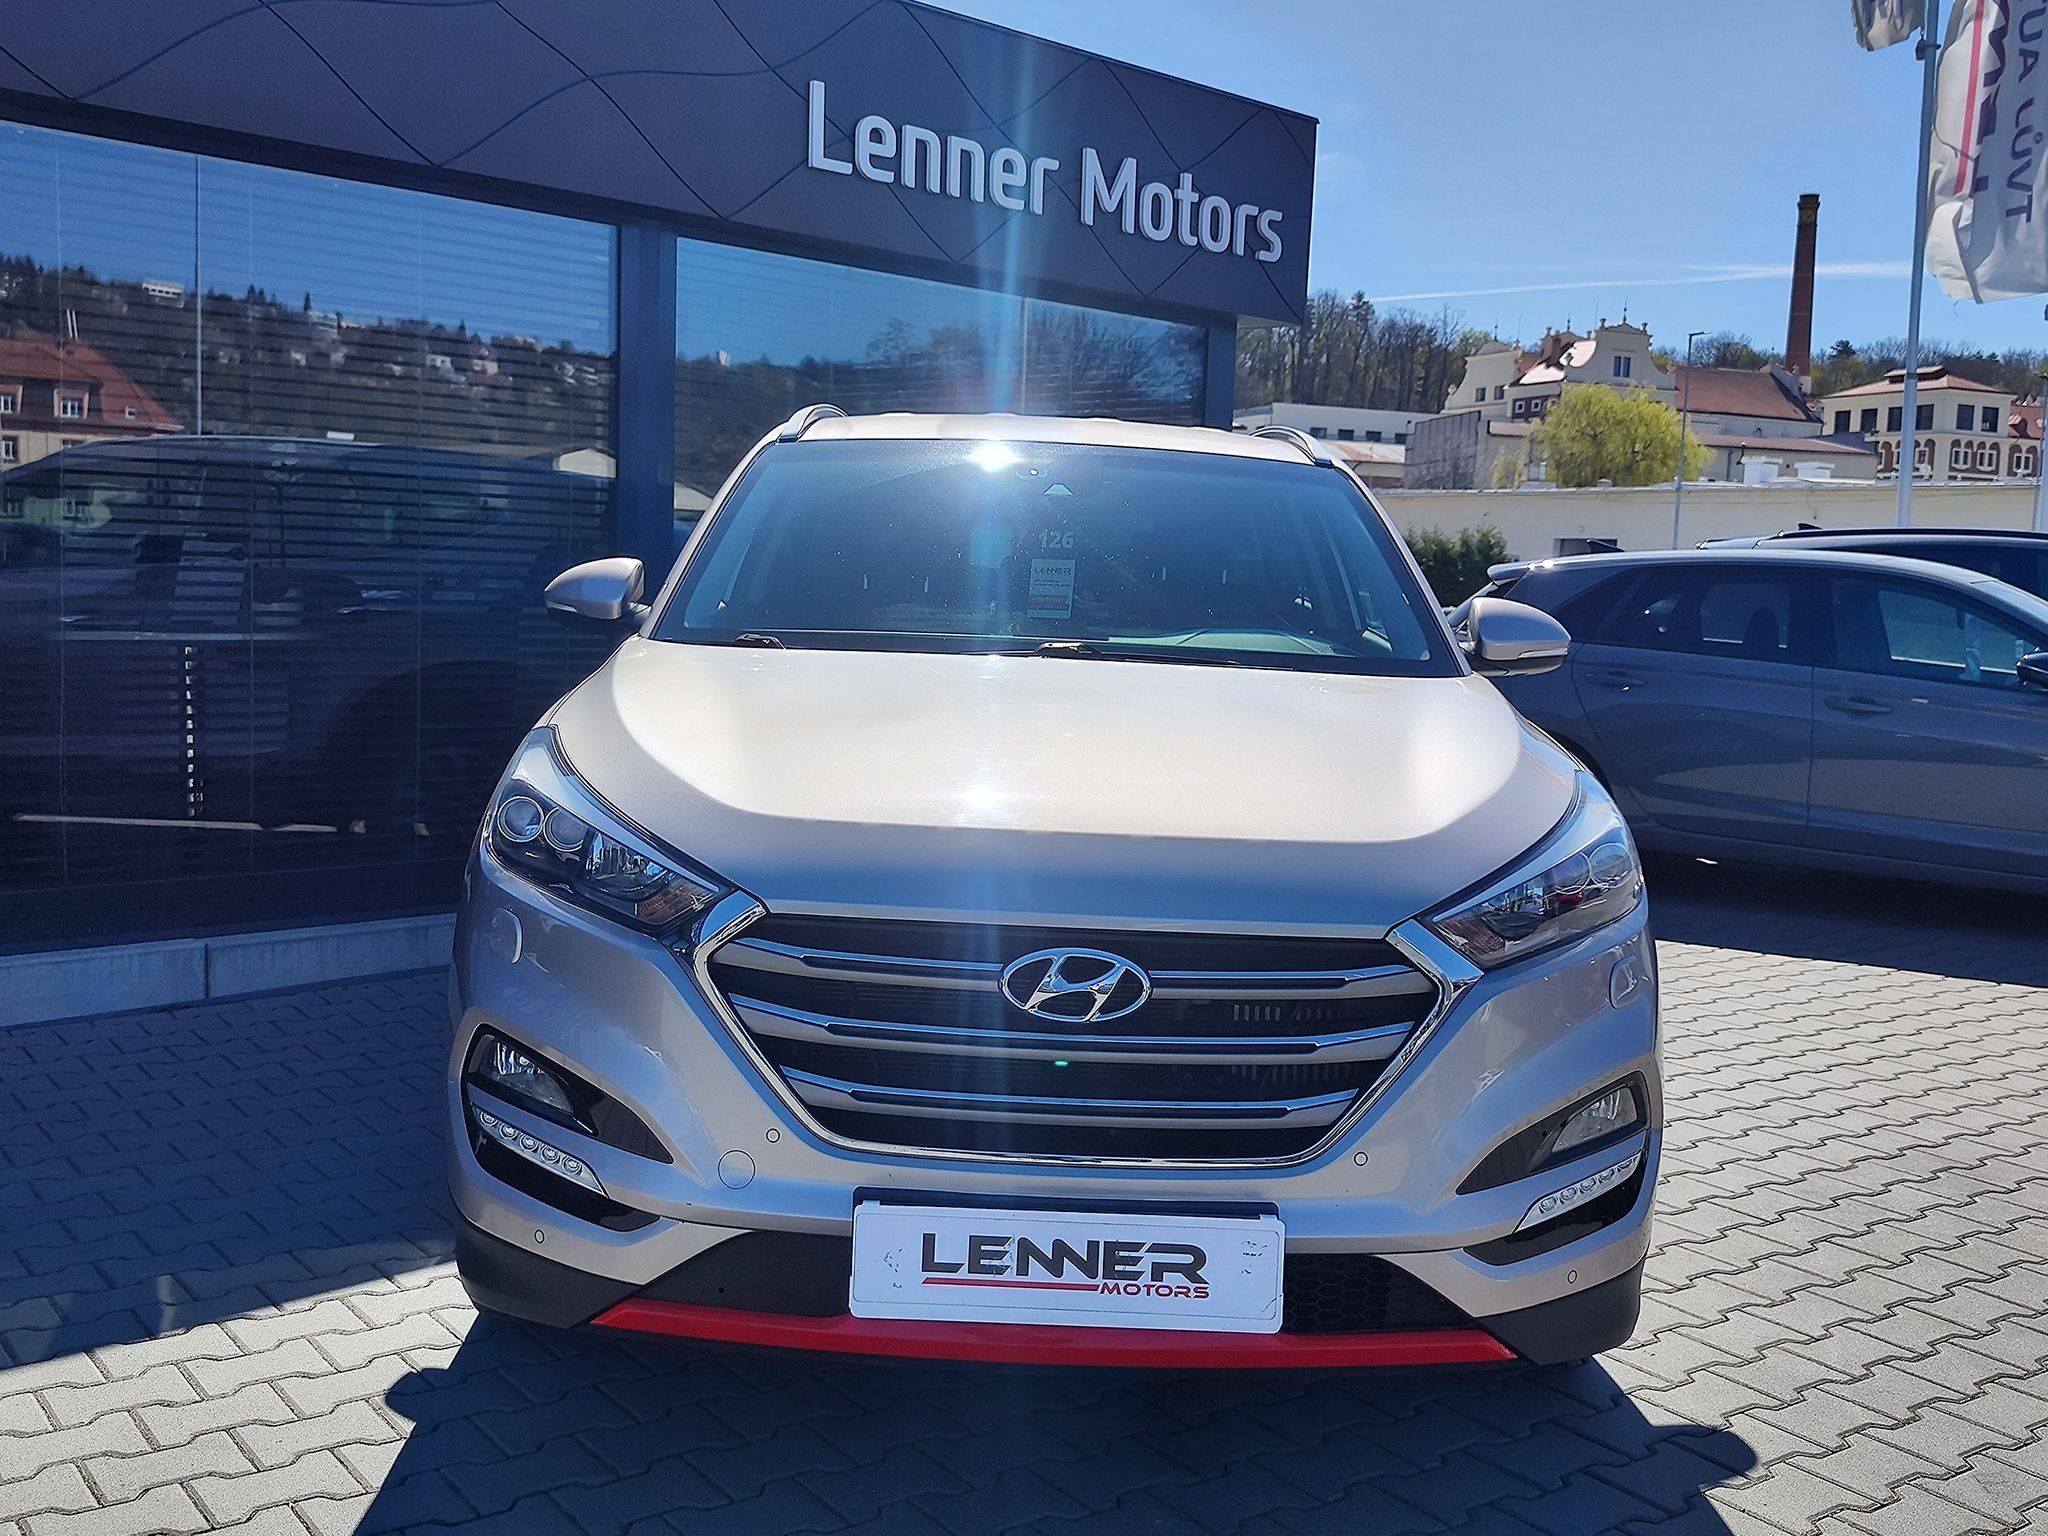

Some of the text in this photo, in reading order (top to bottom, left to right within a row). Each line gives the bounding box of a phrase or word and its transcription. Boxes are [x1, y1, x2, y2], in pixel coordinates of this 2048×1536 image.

[808, 80, 1284, 263] Lenner Motors
[1039, 531, 1074, 549] 126
[921, 1232, 1208, 1284] LENNER
[1099, 1281, 1210, 1299] MOTORS
